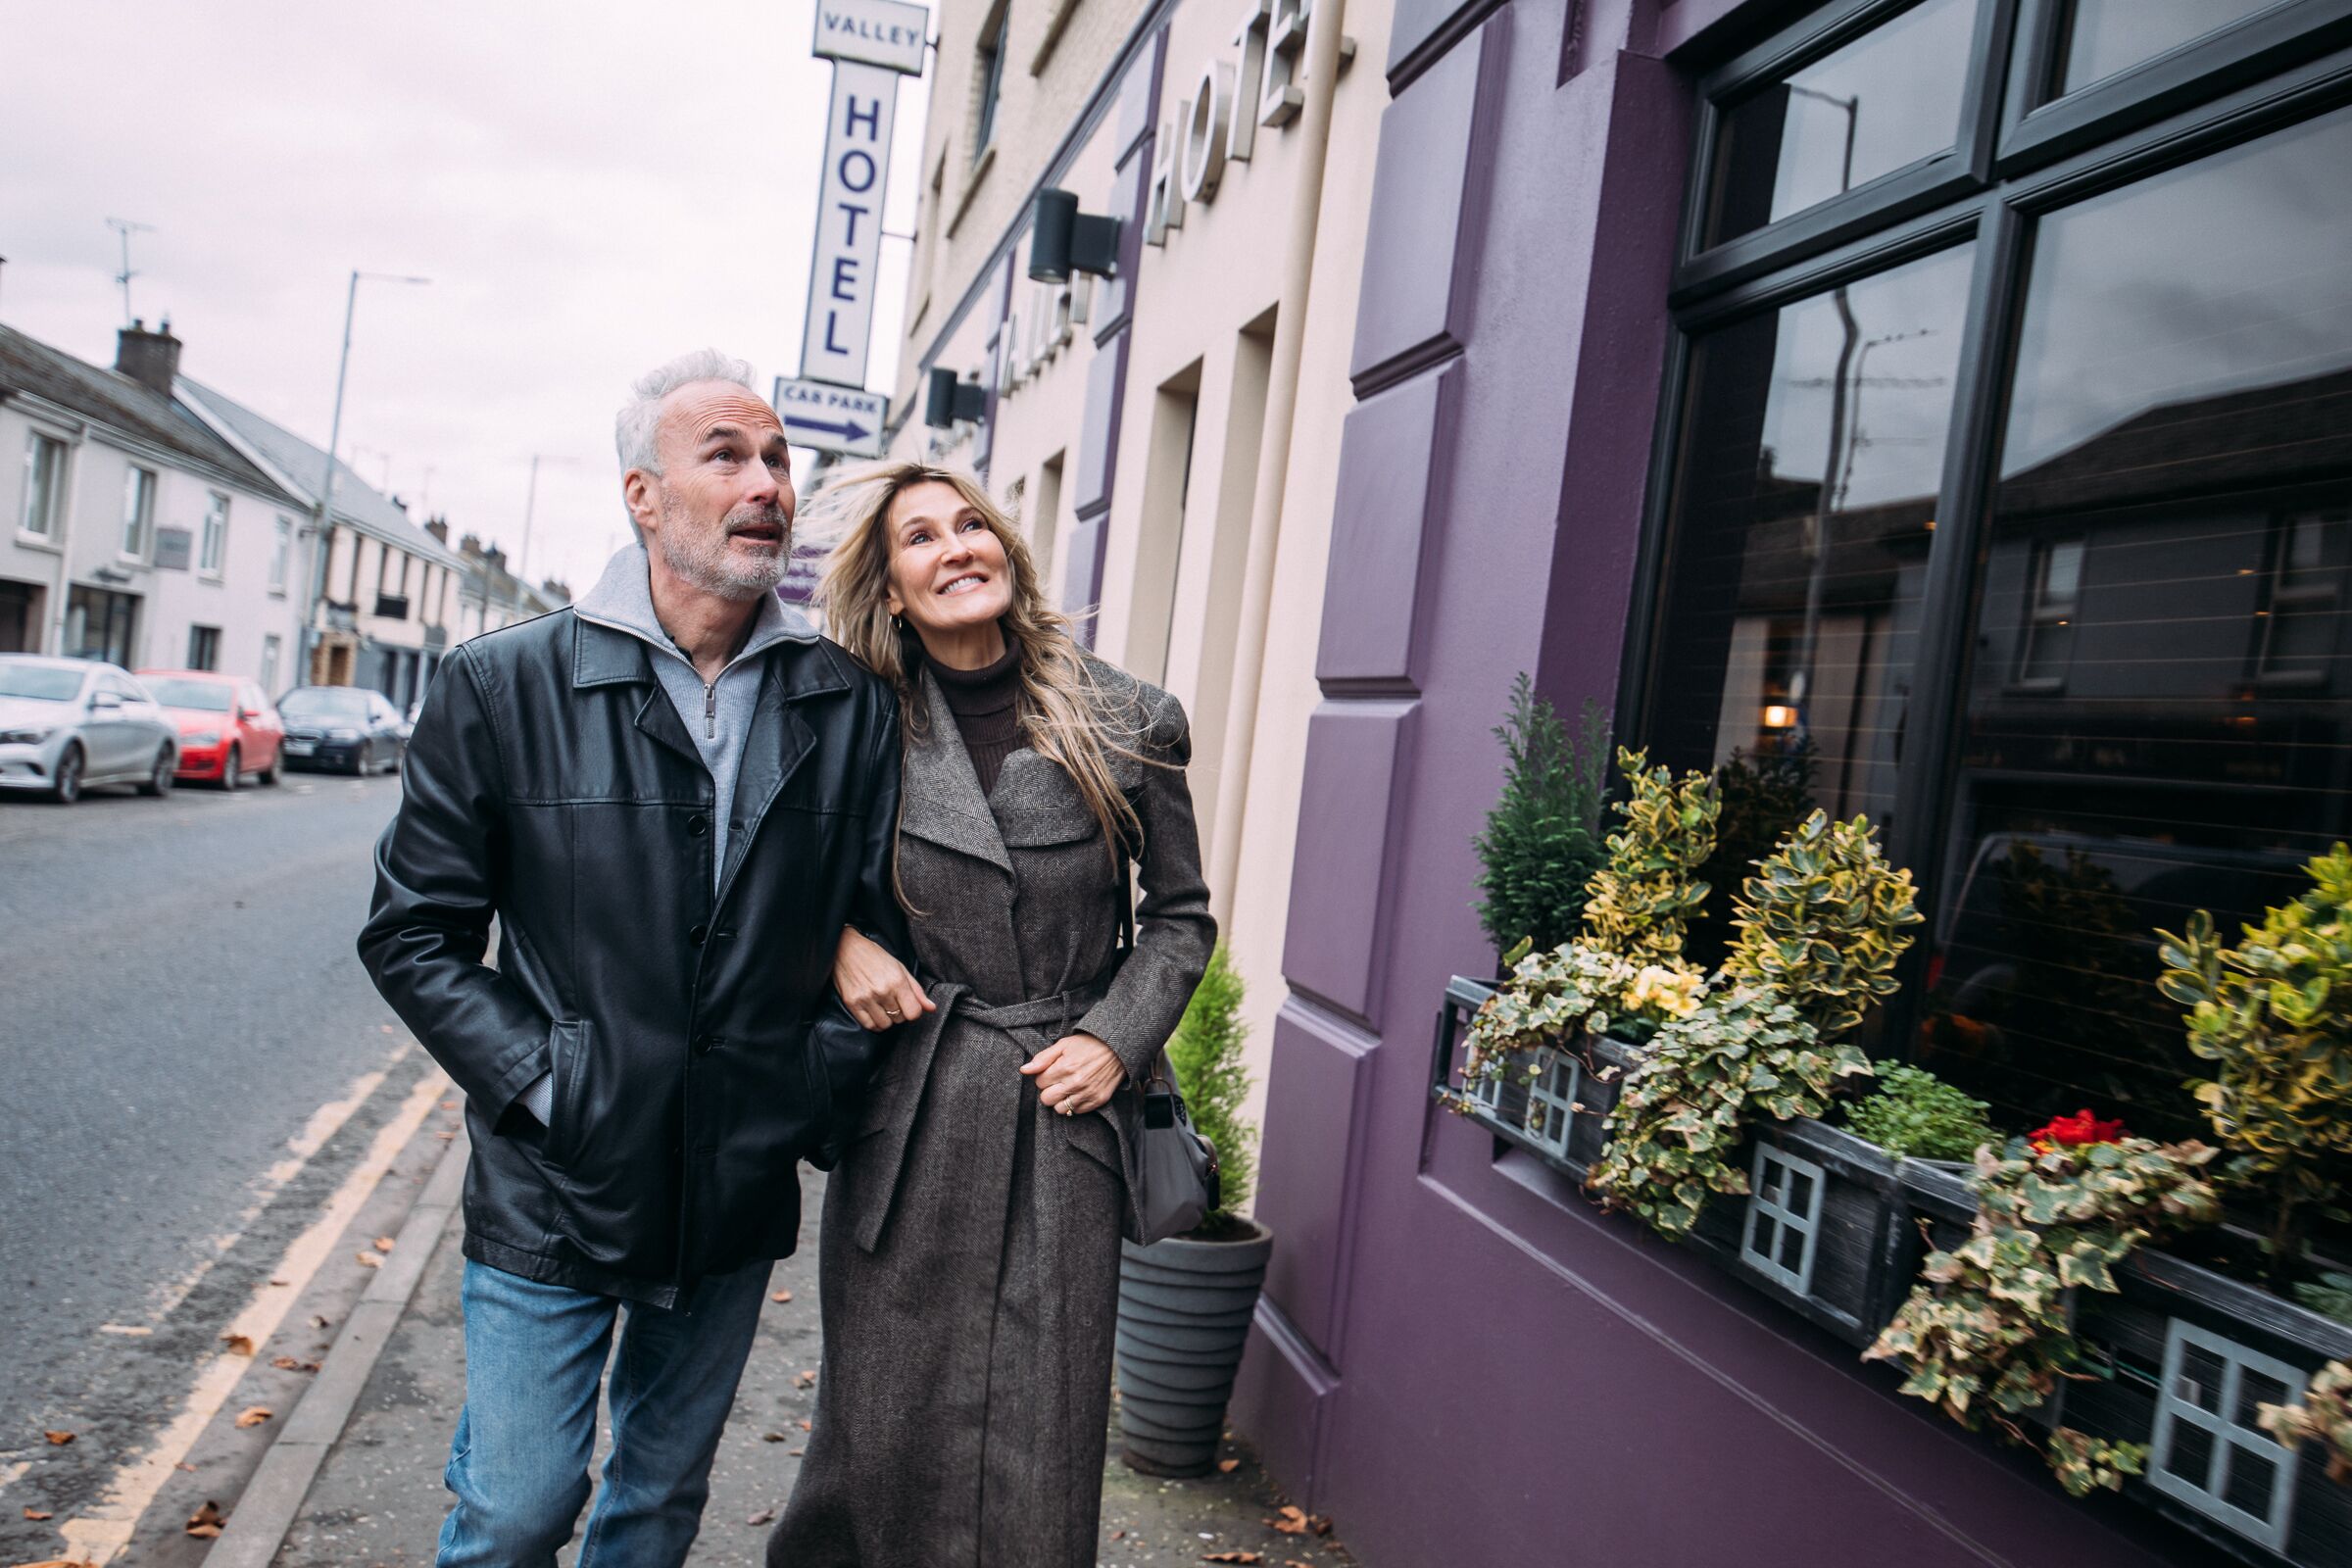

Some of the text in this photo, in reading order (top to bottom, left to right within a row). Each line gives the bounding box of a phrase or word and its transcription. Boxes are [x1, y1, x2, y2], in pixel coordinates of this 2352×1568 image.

[824, 11, 918, 47] VALLEY
[824, 94, 881, 356] HOTEL
[785, 385, 877, 413] CAR PARK
